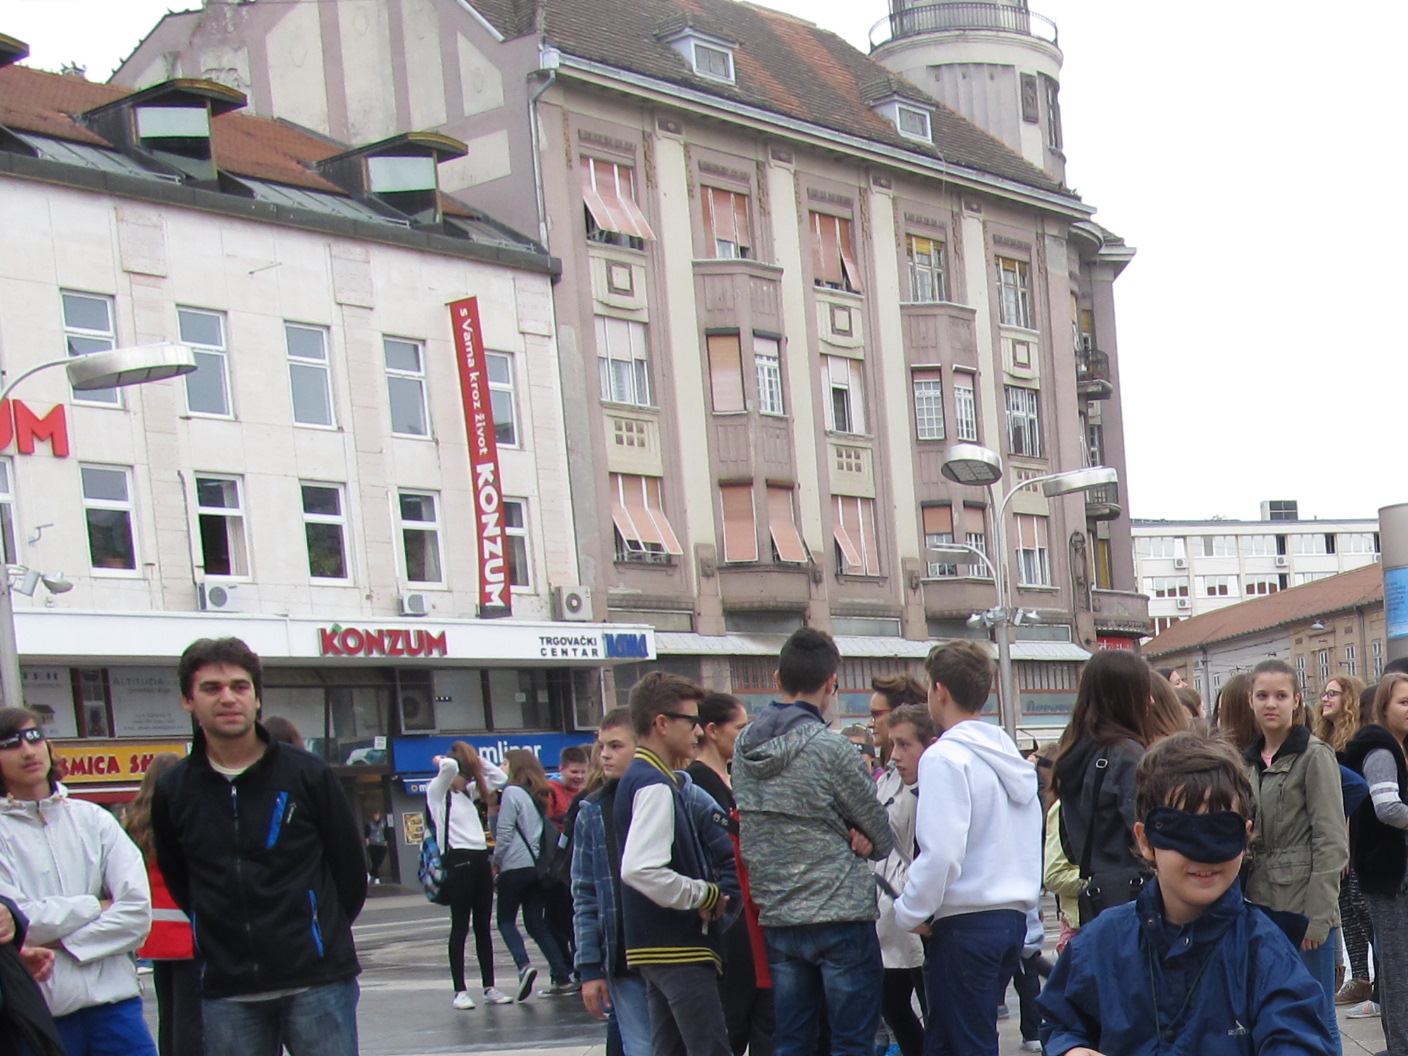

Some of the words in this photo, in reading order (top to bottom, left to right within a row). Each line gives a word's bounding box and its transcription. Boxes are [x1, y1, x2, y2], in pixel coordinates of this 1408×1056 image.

[459, 307, 468, 317] s
[461, 318, 475, 368] Vama
[469, 371, 481, 410] kroz
[474, 413, 488, 455] život
[476, 462, 506, 607] KONZUM
[317, 626, 448, 656] KONZUM
[539, 635, 598, 646] TRGOVAČKI
[540, 647, 599, 657] CENTAR
[60, 755, 121, 776] SMICA
[130, 754, 155, 774] SH
